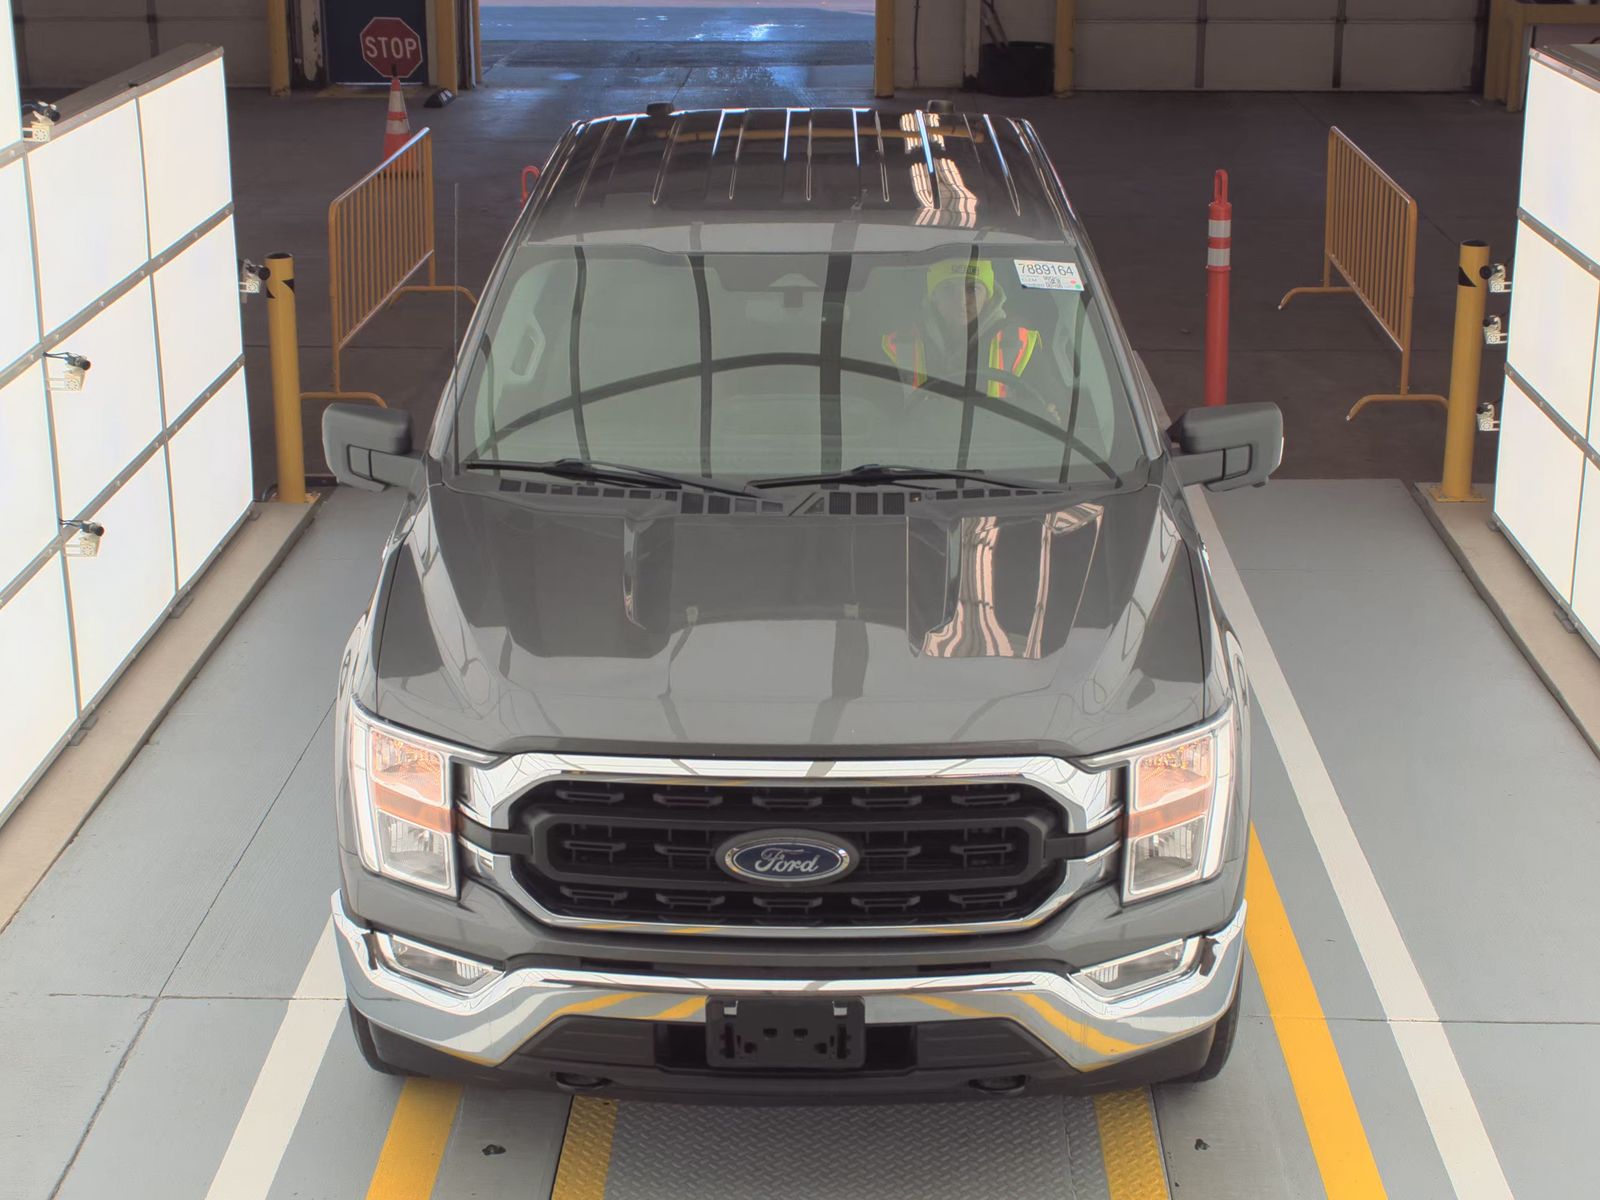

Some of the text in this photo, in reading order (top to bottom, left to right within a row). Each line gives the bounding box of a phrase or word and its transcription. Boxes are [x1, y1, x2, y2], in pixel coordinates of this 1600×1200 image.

[365, 36, 417, 59] STOP
[1018, 263, 1074, 276] 7889164
[754, 847, 819, 872] Ford
